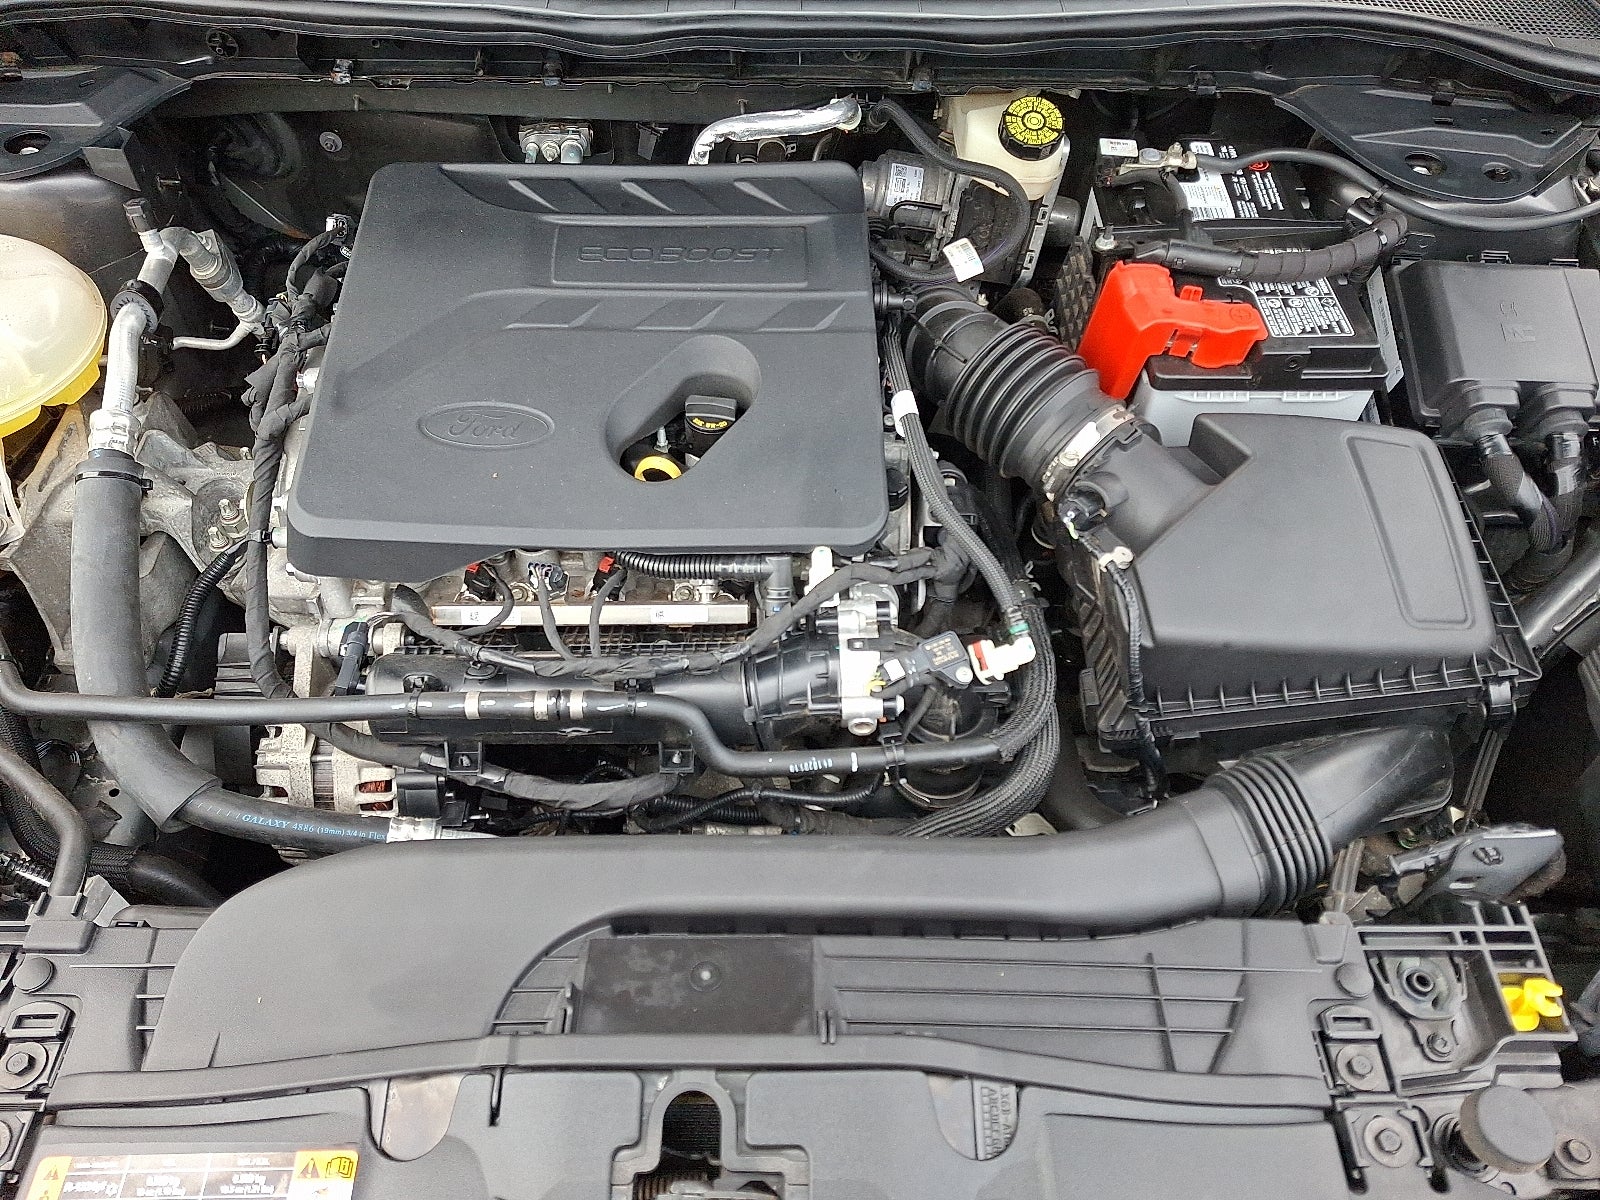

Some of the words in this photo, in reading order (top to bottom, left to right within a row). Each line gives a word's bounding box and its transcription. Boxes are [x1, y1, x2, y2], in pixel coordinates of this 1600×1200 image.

[577, 246, 784, 264] ECOBOOST
[448, 413, 523, 440] Ford
[241, 814, 291, 829] GALAXY
[292, 822, 315, 833] 4886
[317, 826, 345, 837] (19mm)
[368, 831, 386, 841] Flex
